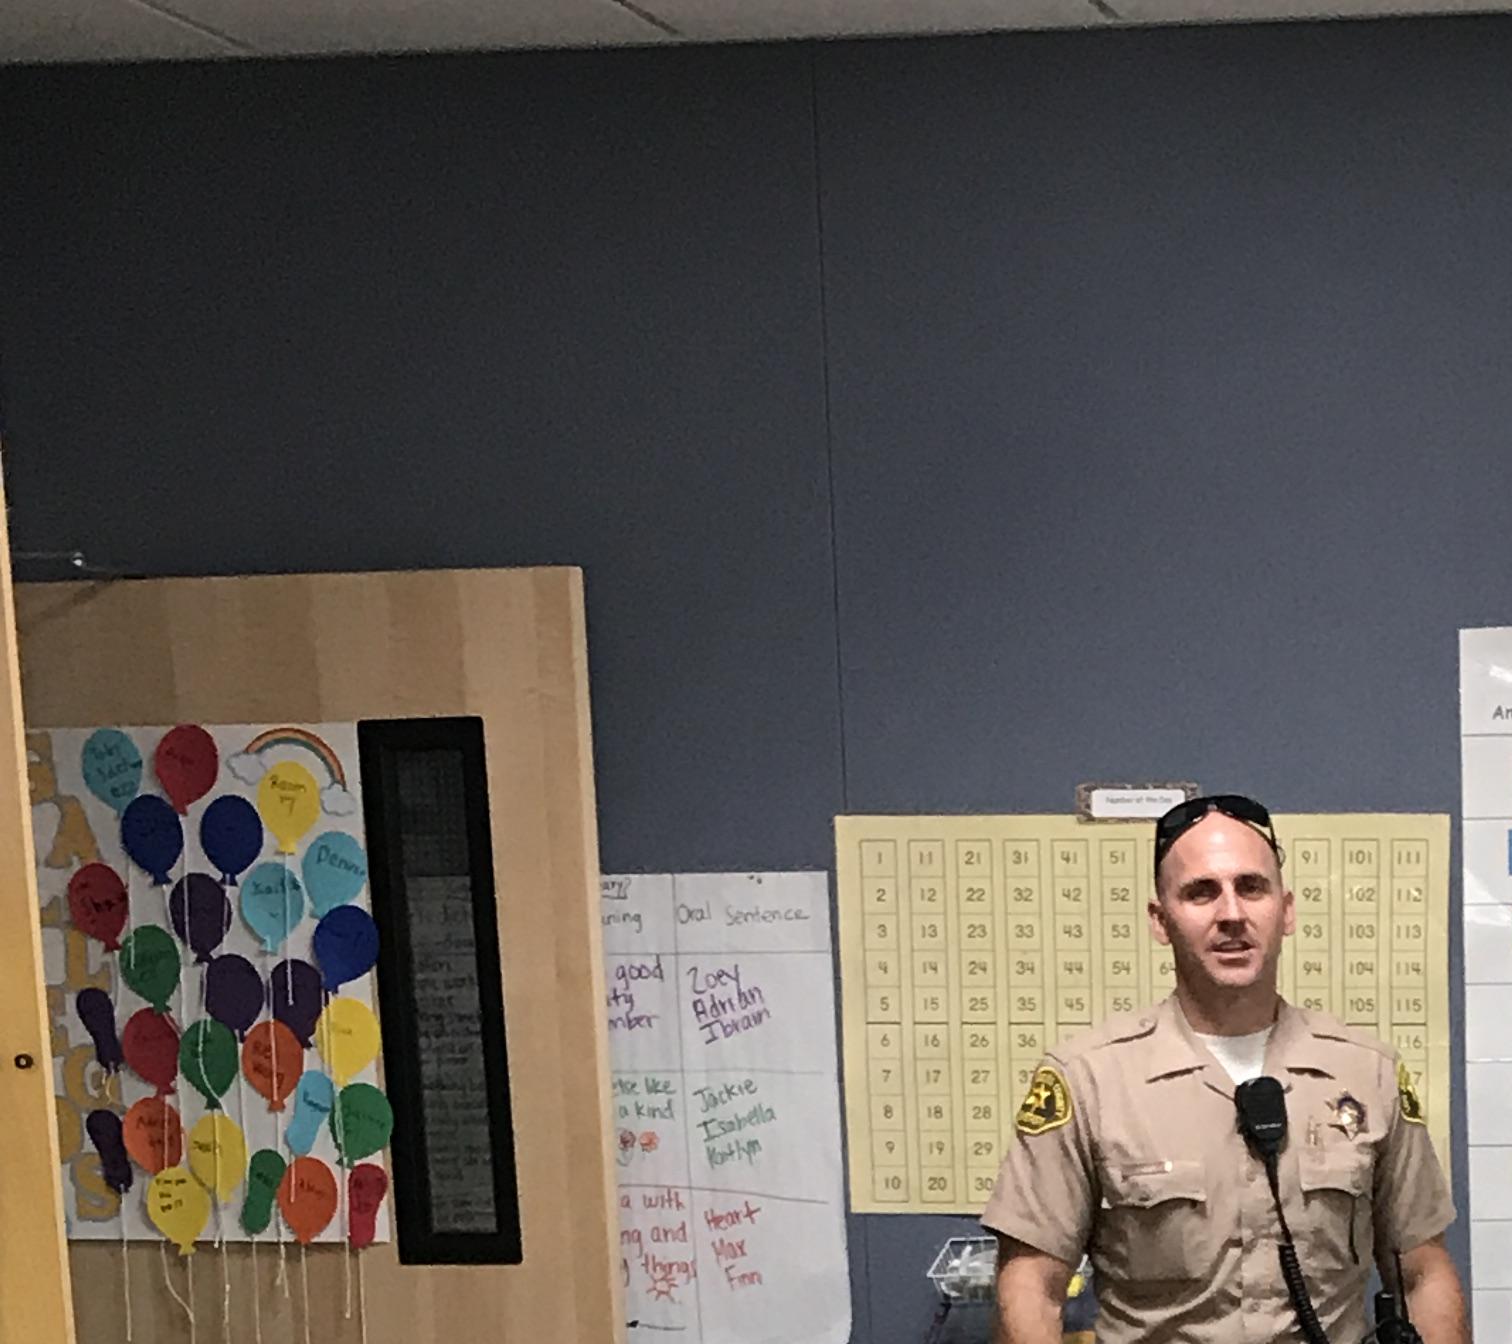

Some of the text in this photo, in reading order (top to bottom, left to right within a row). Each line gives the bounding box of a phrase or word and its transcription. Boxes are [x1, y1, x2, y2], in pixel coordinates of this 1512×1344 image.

[877, 851, 883, 865] 1
[919, 850, 934, 865] 11
[964, 850, 981, 866] 21
[1109, 850, 1126, 865] 51
[876, 887, 887, 903] 2
[920, 887, 937, 903] 12
[965, 887, 986, 903] 22
[1013, 886, 1034, 903] 32
[1061, 887, 1082, 903] 42
[1301, 886, 1322, 903] 92
[677, 901, 810, 926] Oral Sentence
[876, 923, 888, 939] 3
[921, 923, 938, 939] 13
[967, 923, 988, 939] 23
[1348, 924, 1376, 940] 103
[616, 953, 664, 990] good
[877, 961, 889, 975] 4
[1015, 960, 1036, 976] 34
[1111, 960, 1132, 976] 54
[1302, 960, 1323, 976] 94
[879, 995, 890, 1012] 5
[923, 996, 940, 1012] 15
[968, 996, 990, 1012] 25
[1349, 997, 1375, 1013] 105
[880, 1033, 891, 1048] 6
[924, 1033, 941, 1048] 16
[1017, 1033, 1037, 1048] 36
[881, 1068, 892, 1083] 7
[970, 1069, 991, 1085] 27
[635, 1099, 675, 1120] kind
[882, 1104, 894, 1120] 8
[927, 1104, 944, 1120] 18
[884, 1140, 896, 1155] 9
[973, 1141, 994, 1157] 29
[884, 1175, 903, 1191] 10
[927, 1176, 948, 1192] 20
[643, 1187, 686, 1211] with
[651, 1221, 687, 1243] and
